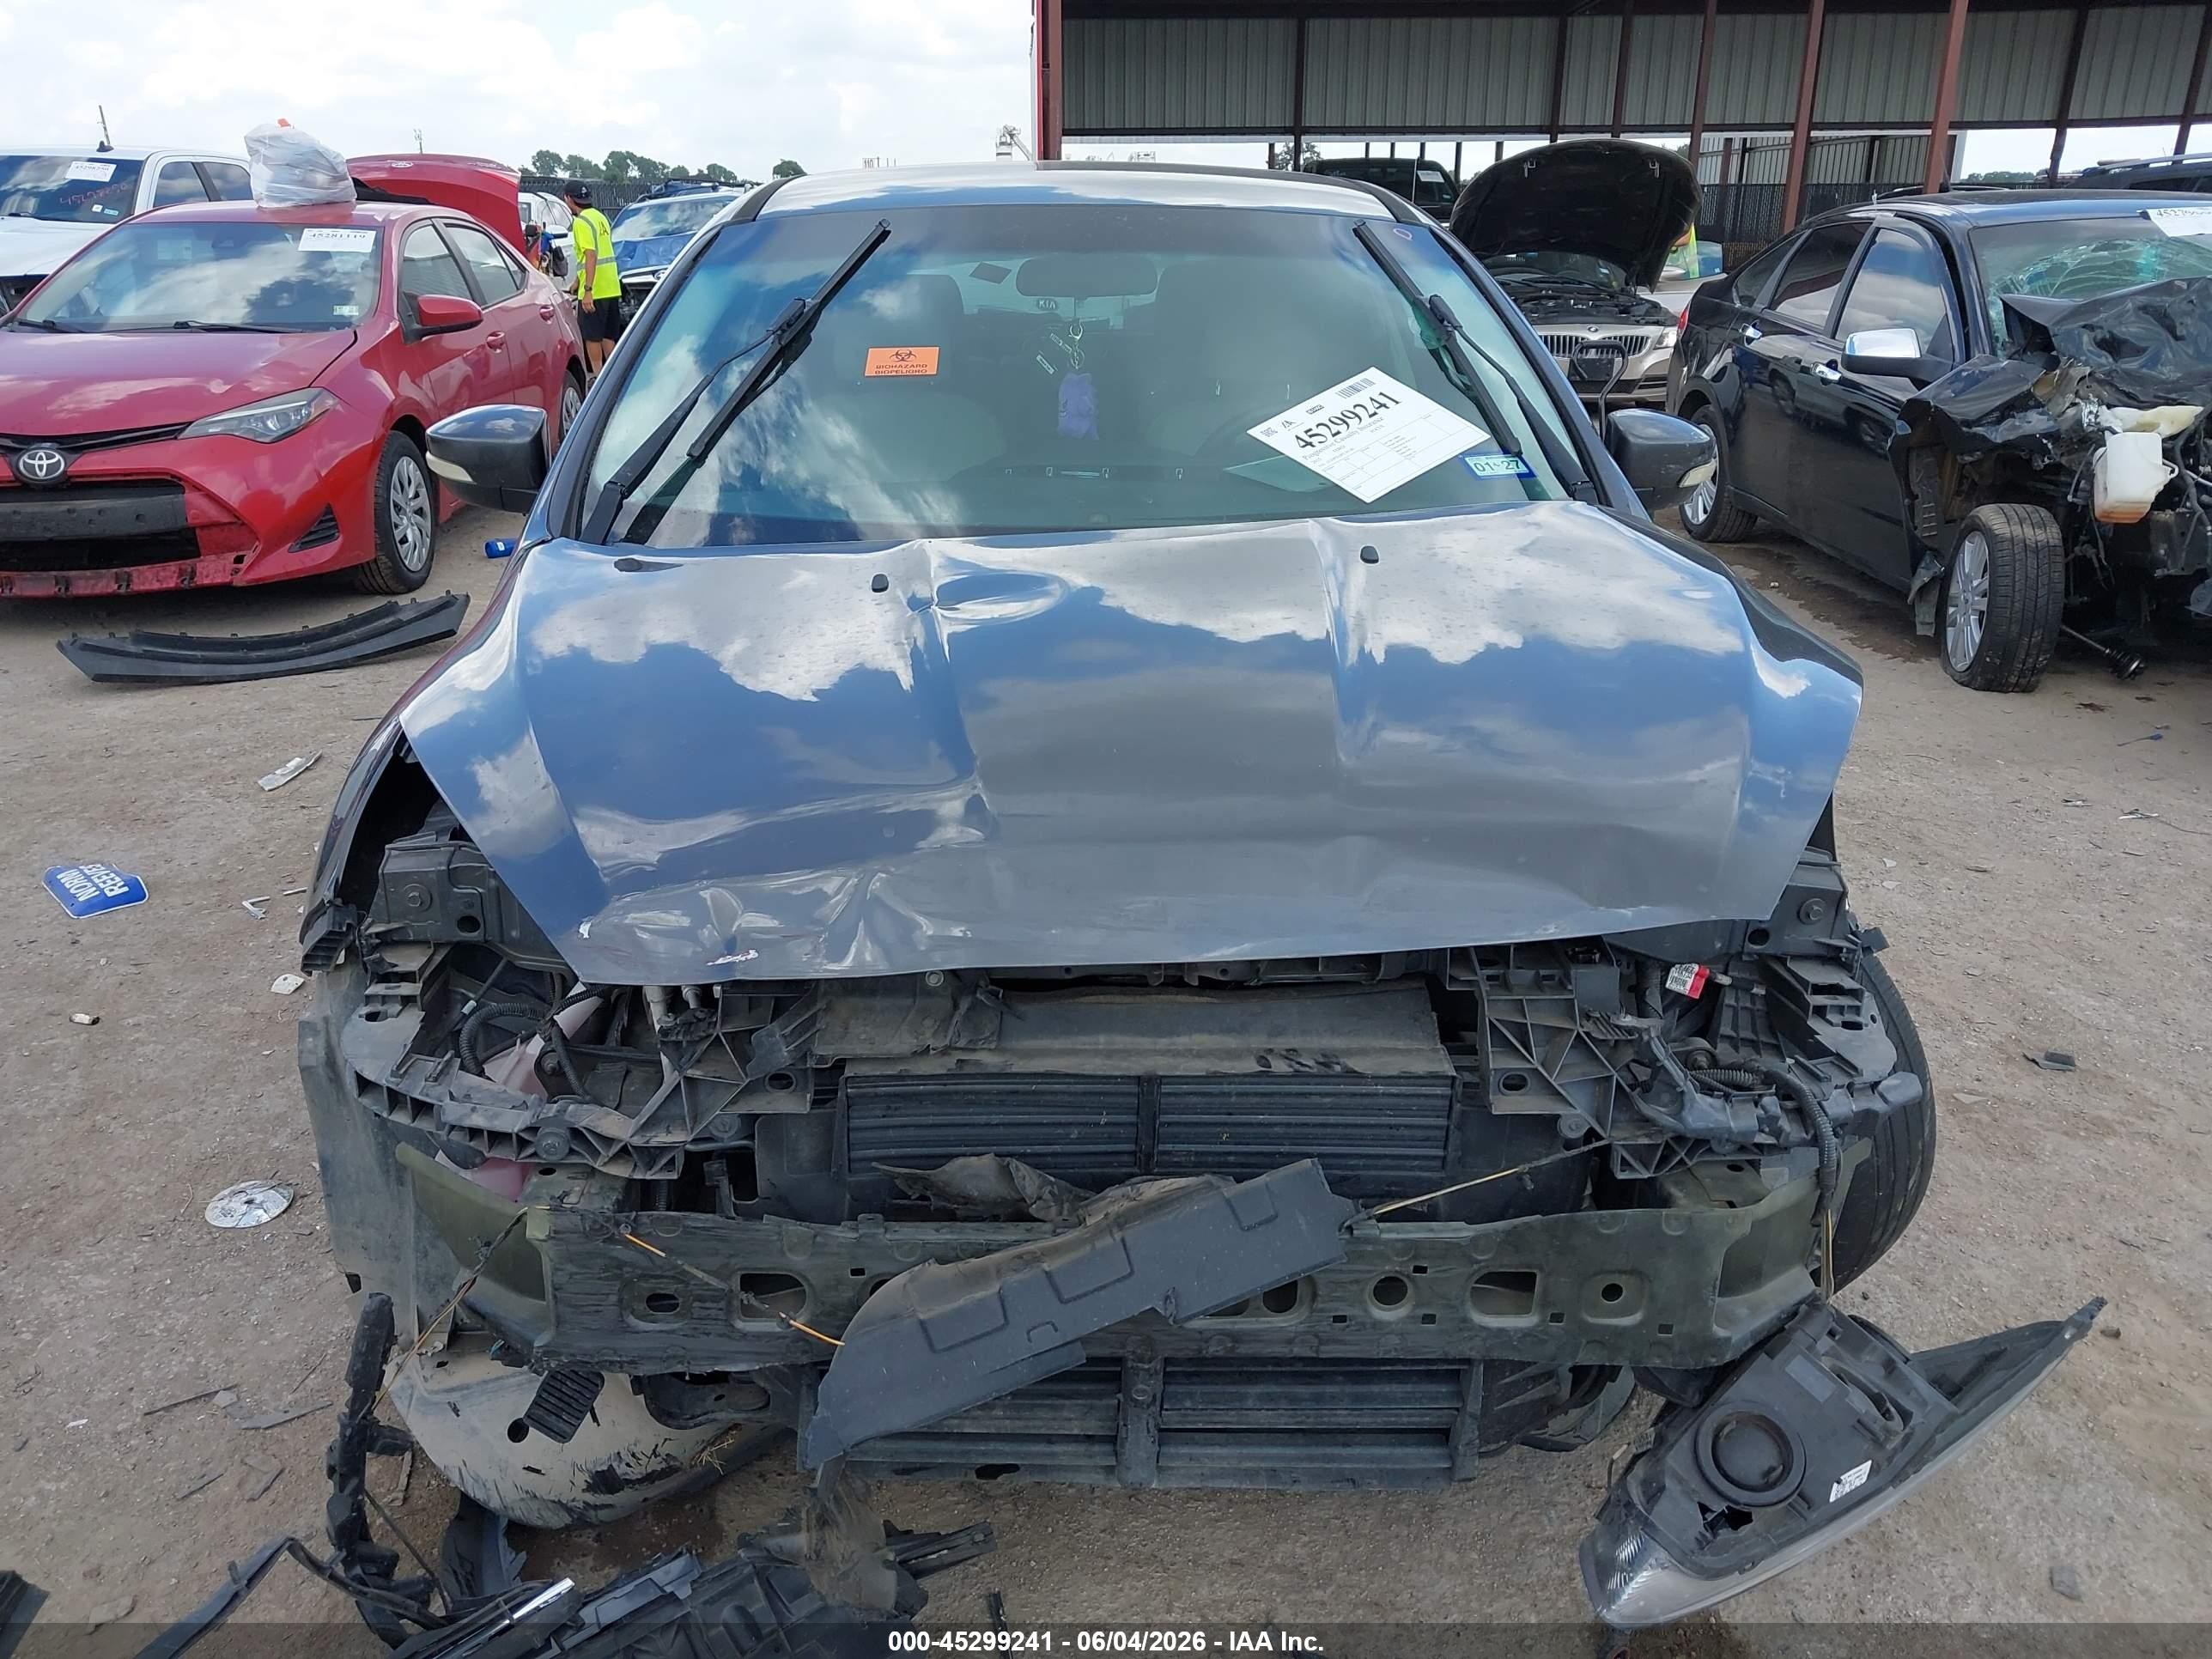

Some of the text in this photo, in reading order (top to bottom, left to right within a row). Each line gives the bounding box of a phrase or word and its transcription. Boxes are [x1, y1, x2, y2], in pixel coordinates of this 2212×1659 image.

[1294, 391, 1402, 449] 45299241
[1500, 459, 1520, 470] 27
[56, 868, 100, 902] NORM
